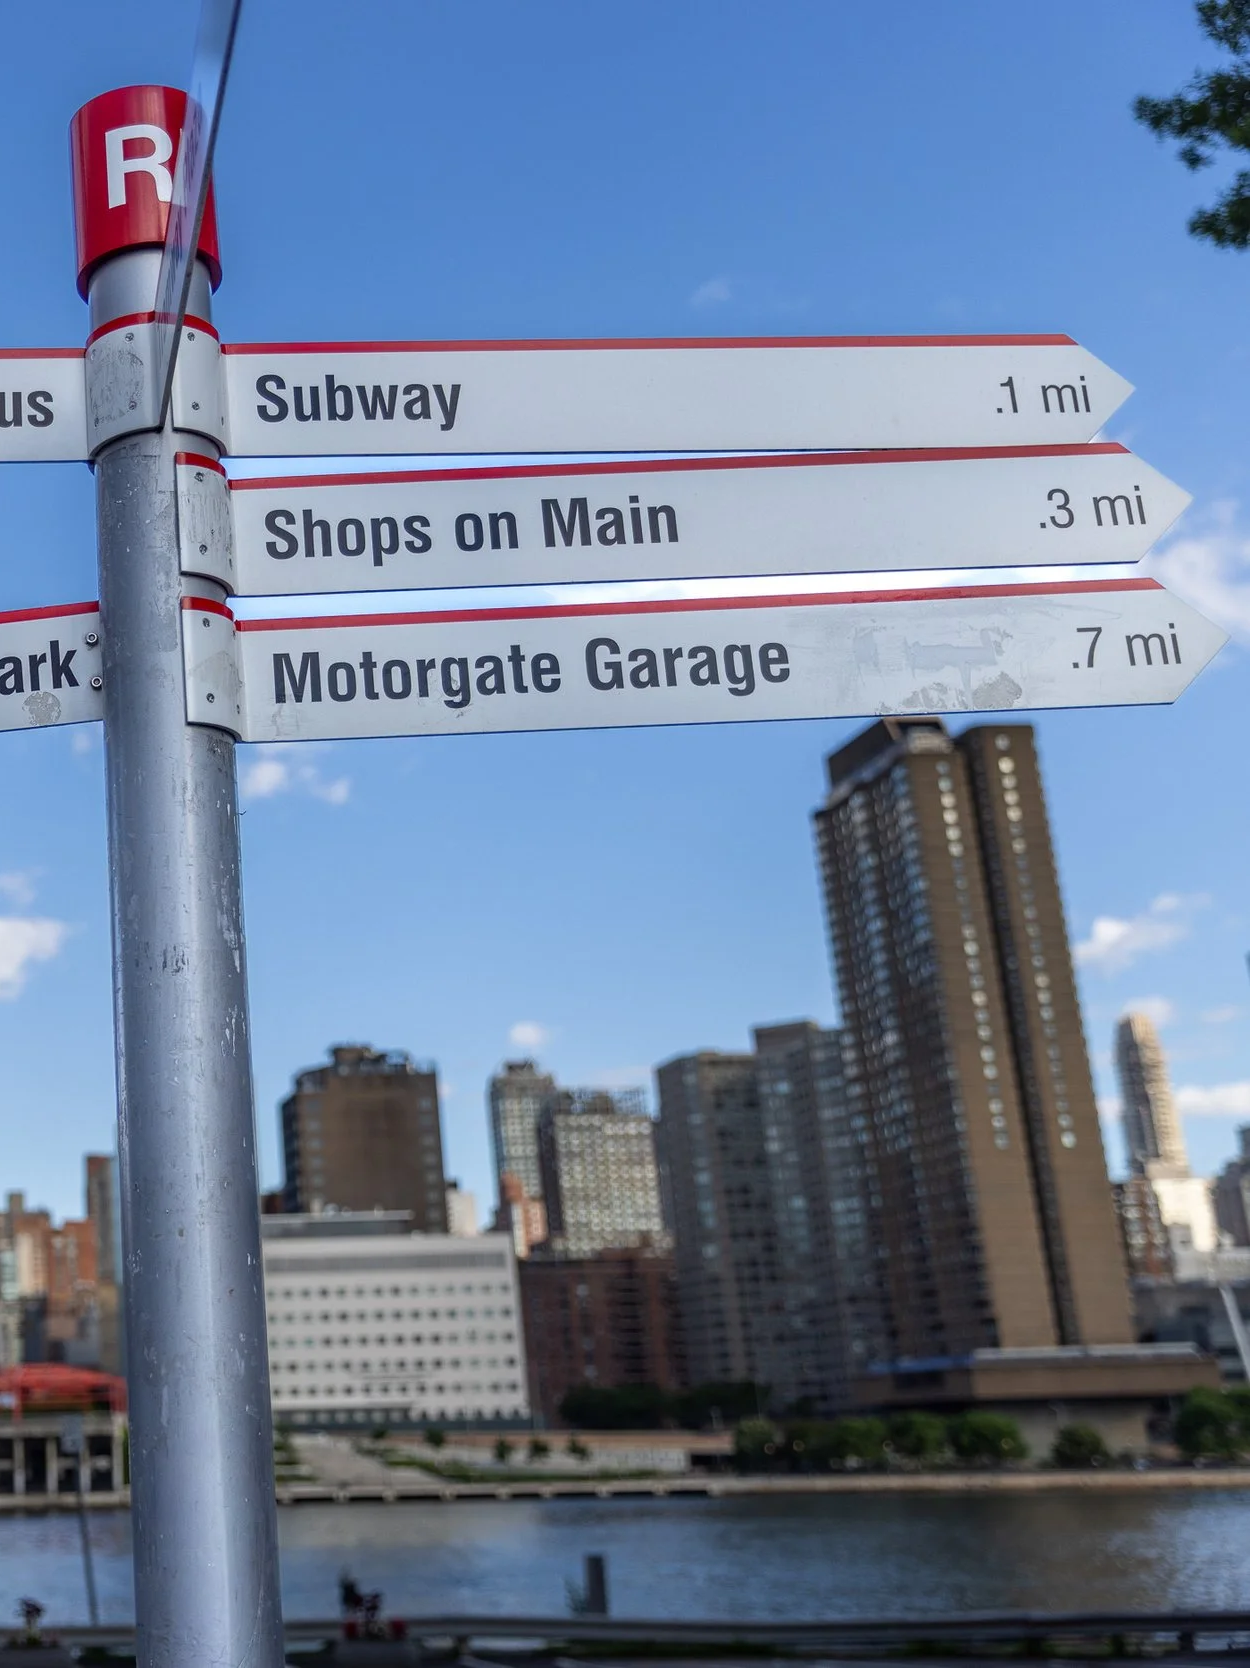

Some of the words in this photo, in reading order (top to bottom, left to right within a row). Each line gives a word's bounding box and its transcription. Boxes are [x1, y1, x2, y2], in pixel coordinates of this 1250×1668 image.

[255, 374, 462, 432] Subway
[996, 376, 1019, 414] .1
[1041, 375, 1091, 413] mi
[264, 508, 433, 567] Shops
[454, 511, 519, 552] on
[540, 494, 679, 548] Main
[1039, 488, 1075, 529] .3
[1092, 485, 1147, 527] mi
[1072, 626, 1103, 669] .7
[1125, 622, 1182, 666] mi
[272, 644, 562, 710] Motorgate
[585, 637, 790, 697] Garage
